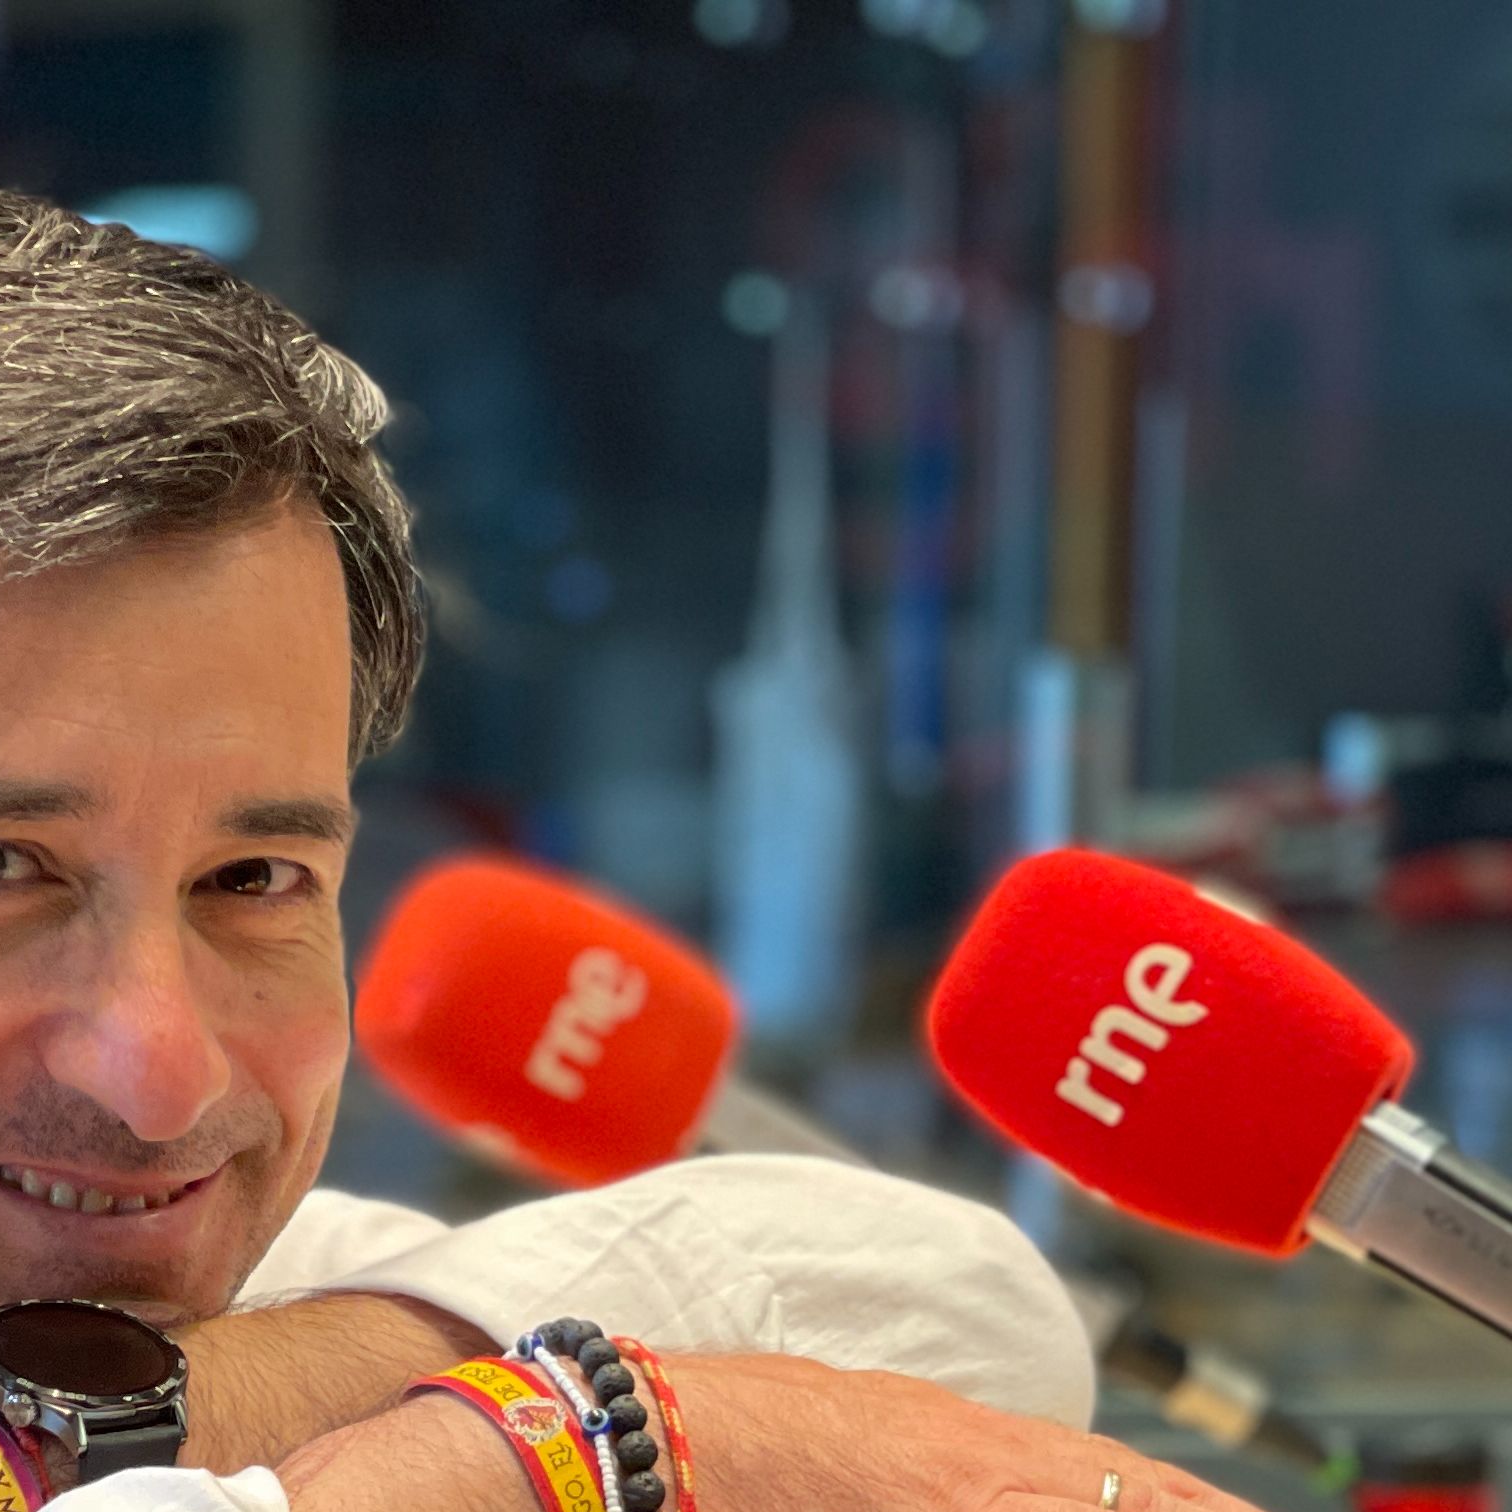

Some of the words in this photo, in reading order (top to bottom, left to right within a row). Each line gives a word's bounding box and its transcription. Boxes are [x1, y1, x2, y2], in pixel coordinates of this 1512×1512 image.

[524, 947, 648, 1101] rne
[1056, 941, 1210, 1128] rne
[494, 1383, 523, 1402] DE
[547, 1442, 574, 1470] EL
